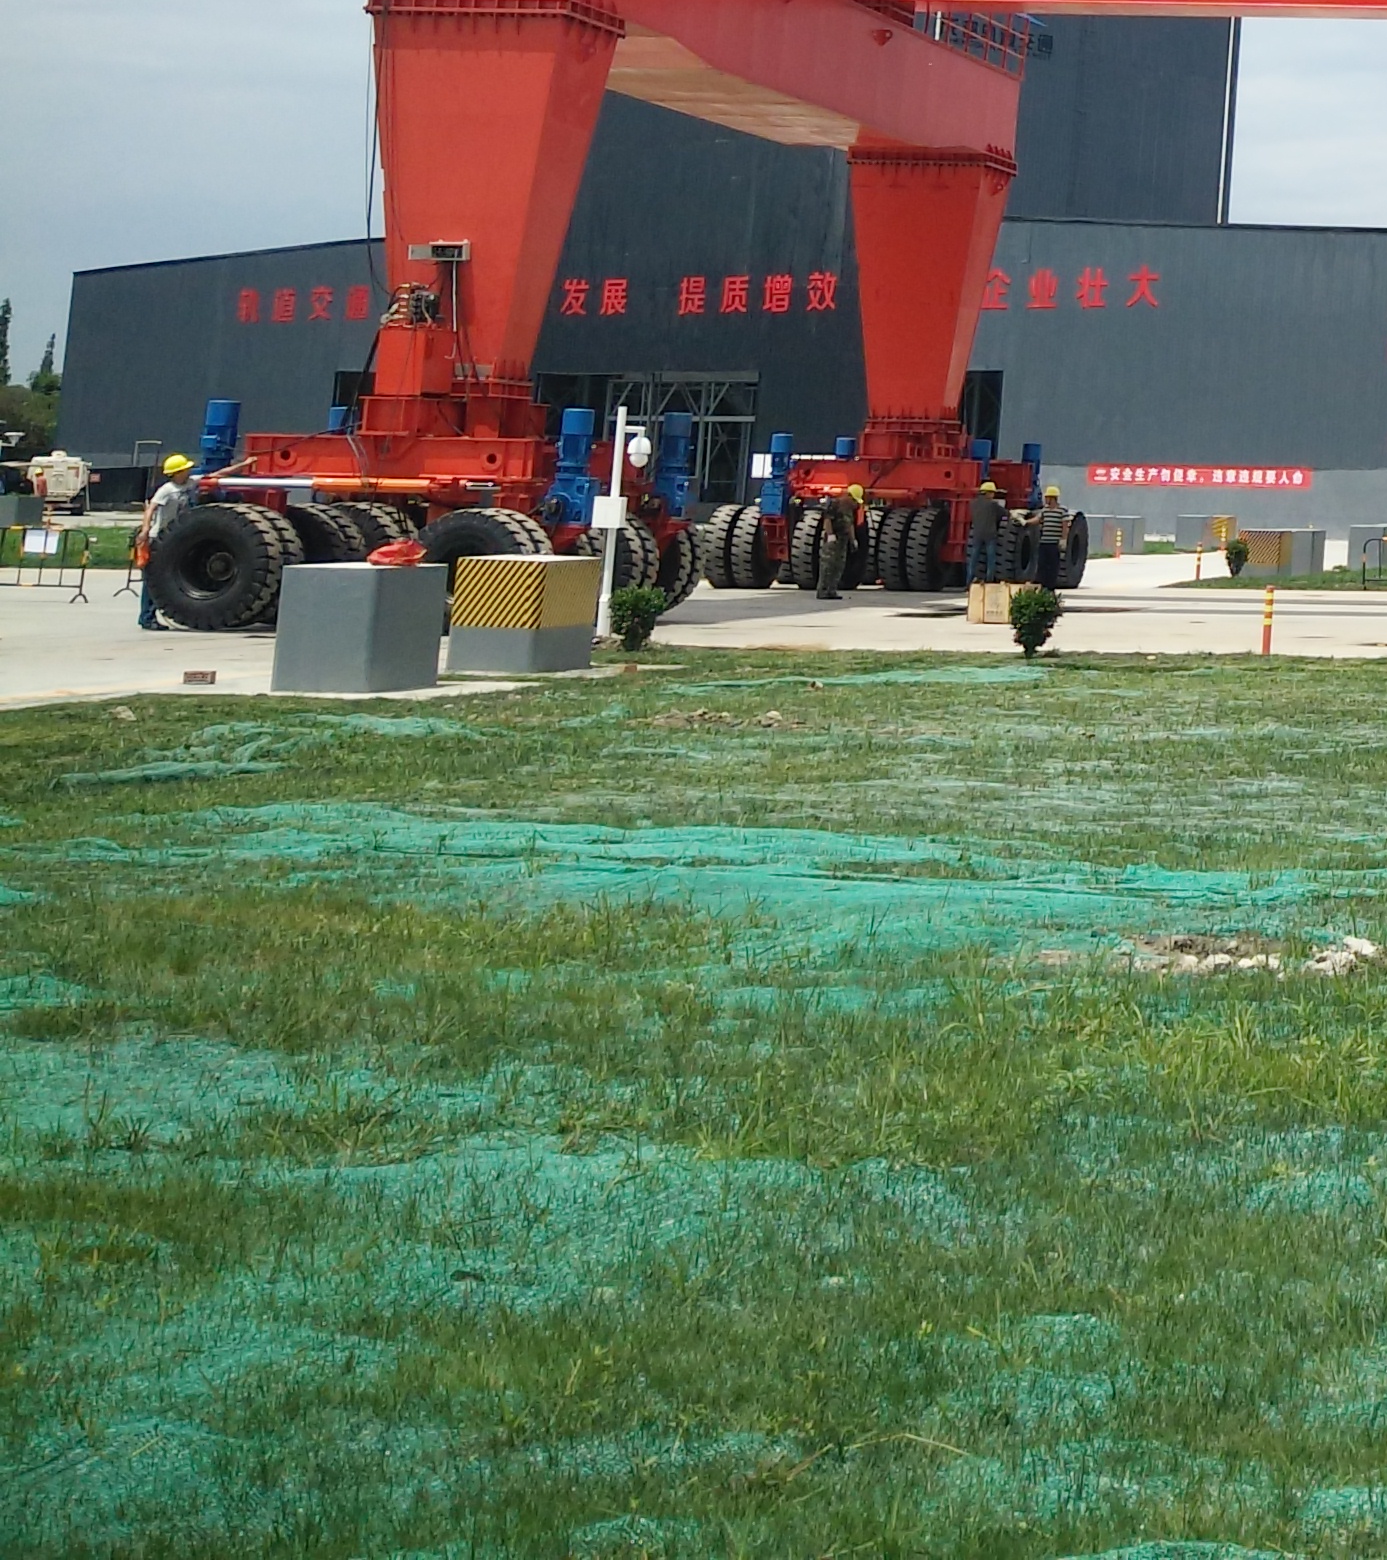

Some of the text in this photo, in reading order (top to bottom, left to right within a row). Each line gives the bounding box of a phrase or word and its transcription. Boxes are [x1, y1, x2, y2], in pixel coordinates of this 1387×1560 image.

[560, 277, 629, 316] 发展
[677, 271, 838, 316] 提质增效
[980, 264, 1160, 310] 企业壮大
